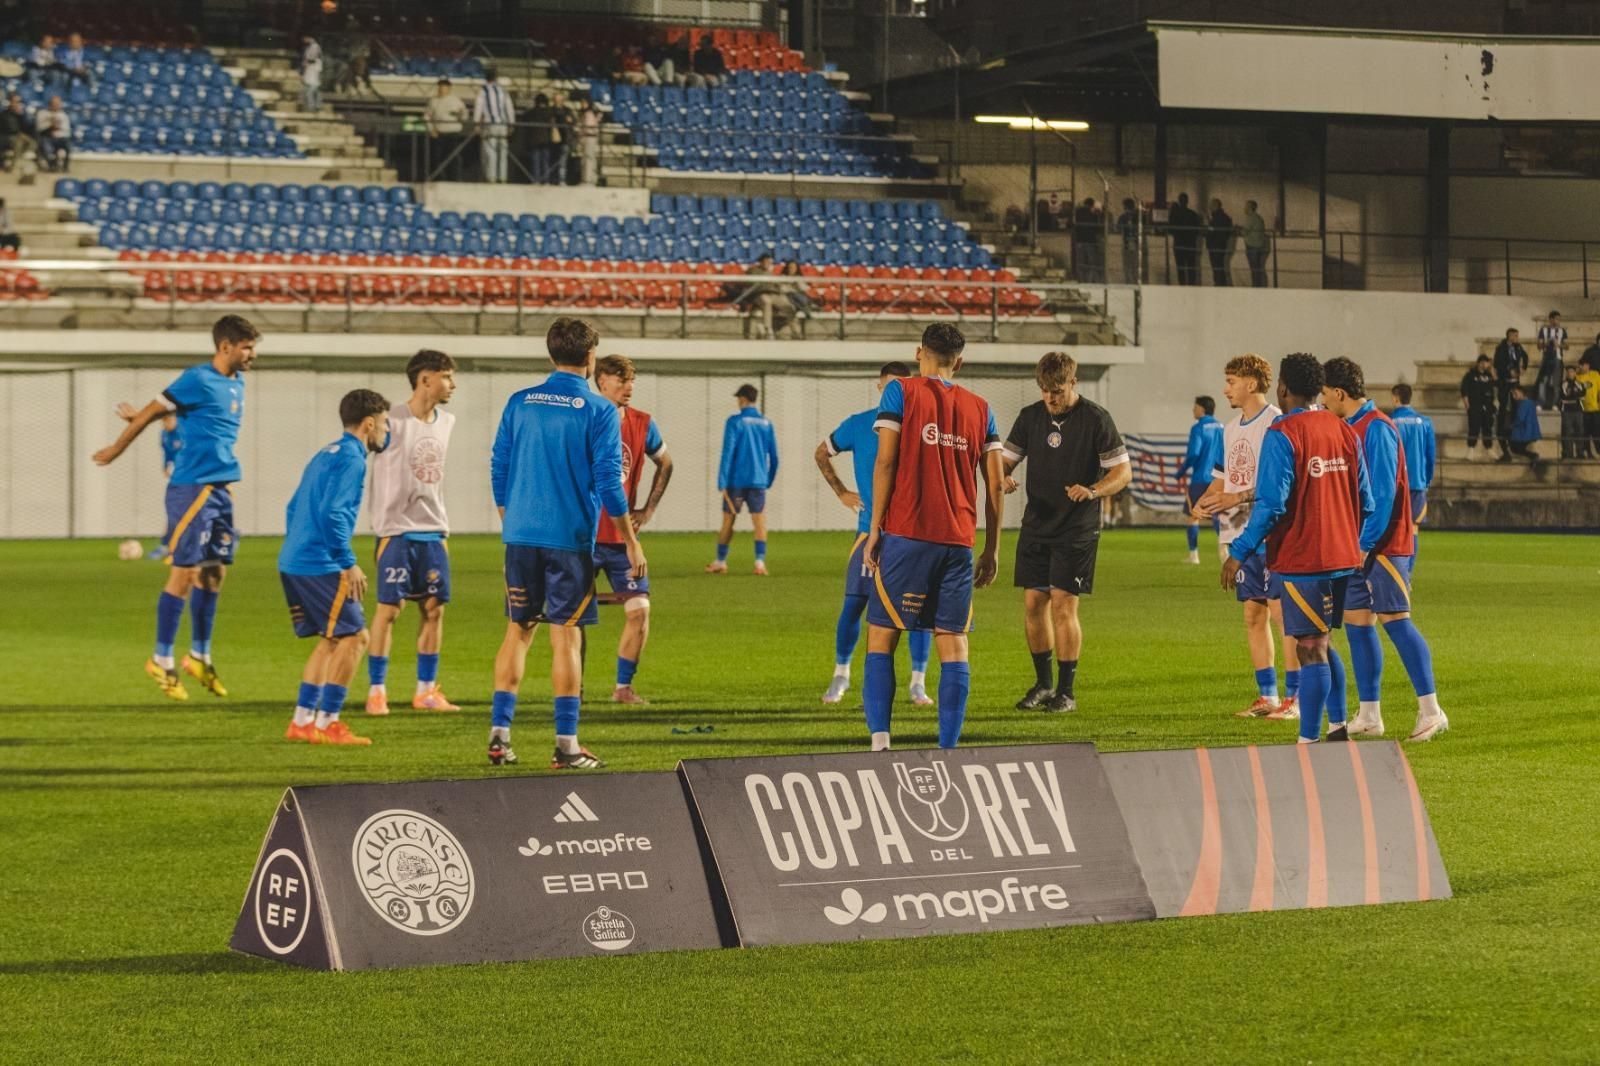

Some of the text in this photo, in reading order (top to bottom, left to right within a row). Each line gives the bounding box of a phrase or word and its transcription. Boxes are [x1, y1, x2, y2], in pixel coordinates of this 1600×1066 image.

[385, 567, 408, 584] 22
[961, 760, 1077, 858] REY
[744, 769, 913, 872] COPA
[555, 832, 653, 857] mapfre
[930, 847, 975, 862] DEL
[893, 877, 1070, 924] mapfre
[590, 919, 625, 930] Estrella
[593, 929, 627, 941] Galicia
